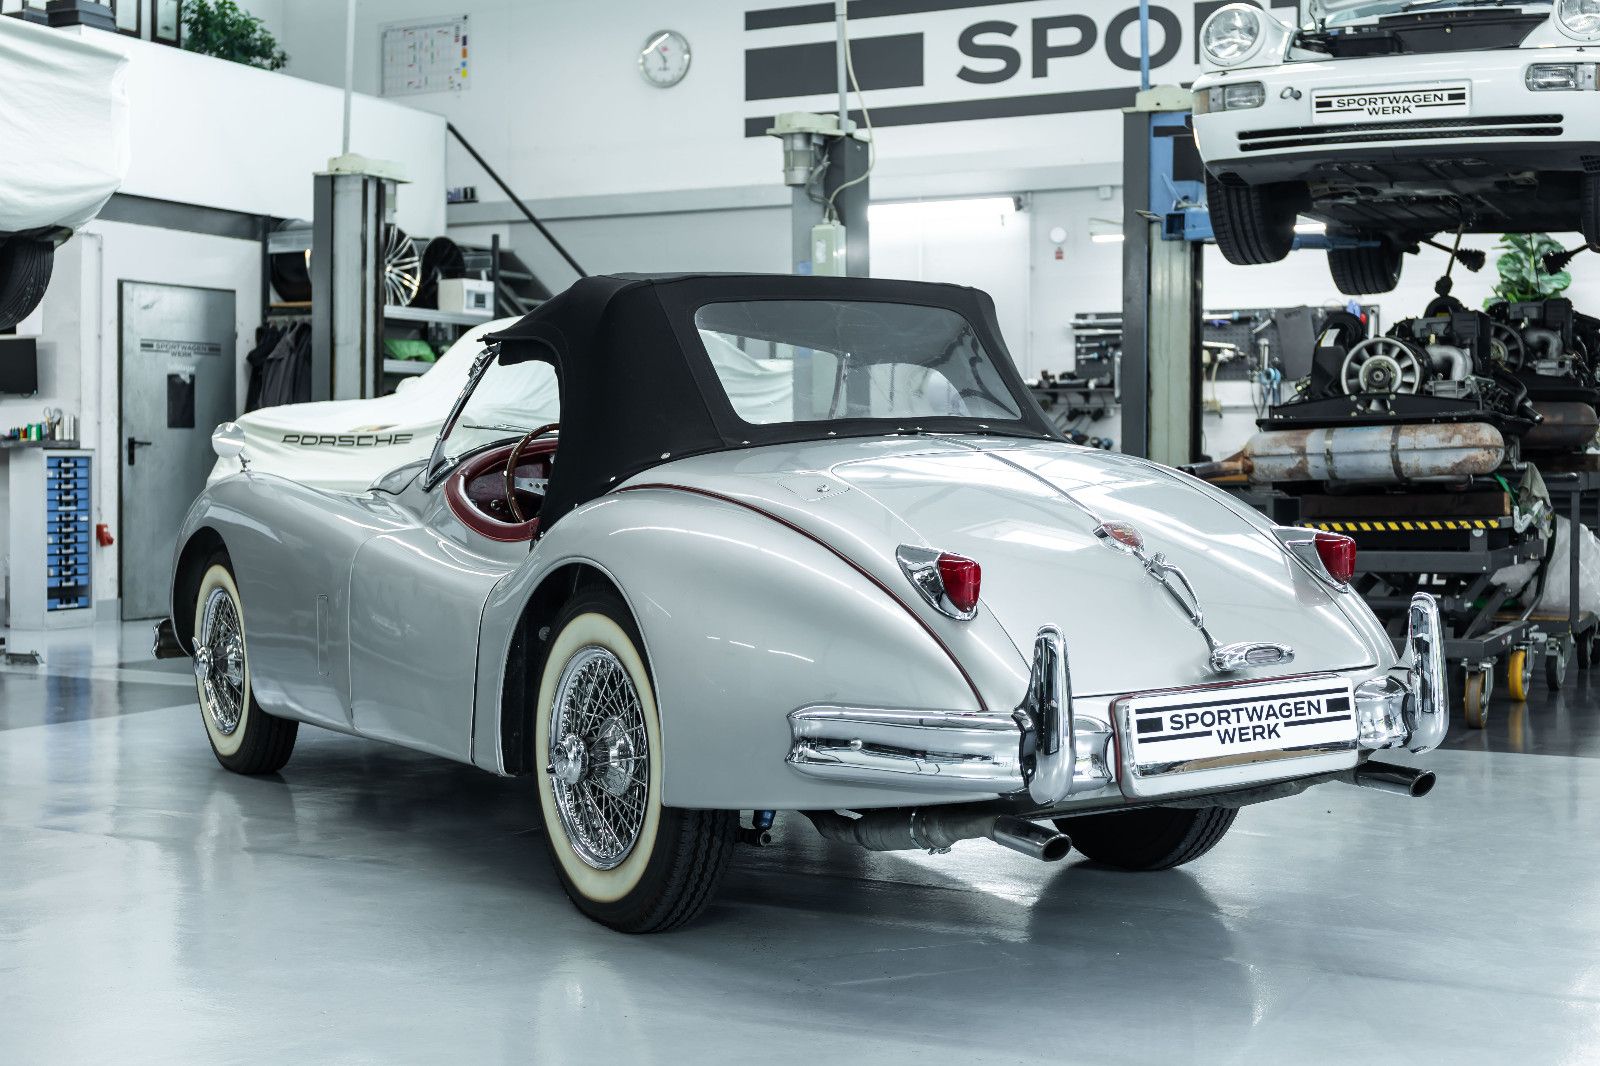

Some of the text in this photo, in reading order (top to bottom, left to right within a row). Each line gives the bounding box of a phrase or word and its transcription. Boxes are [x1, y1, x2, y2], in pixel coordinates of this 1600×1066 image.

[1337, 93, 1444, 108] SPORTWAGEN
[1367, 105, 1413, 116] WERK
[281, 433, 414, 447] PORSCHE
[1169, 699, 1321, 731] SPORTWAGEN
[1216, 723, 1281, 745] WERK
